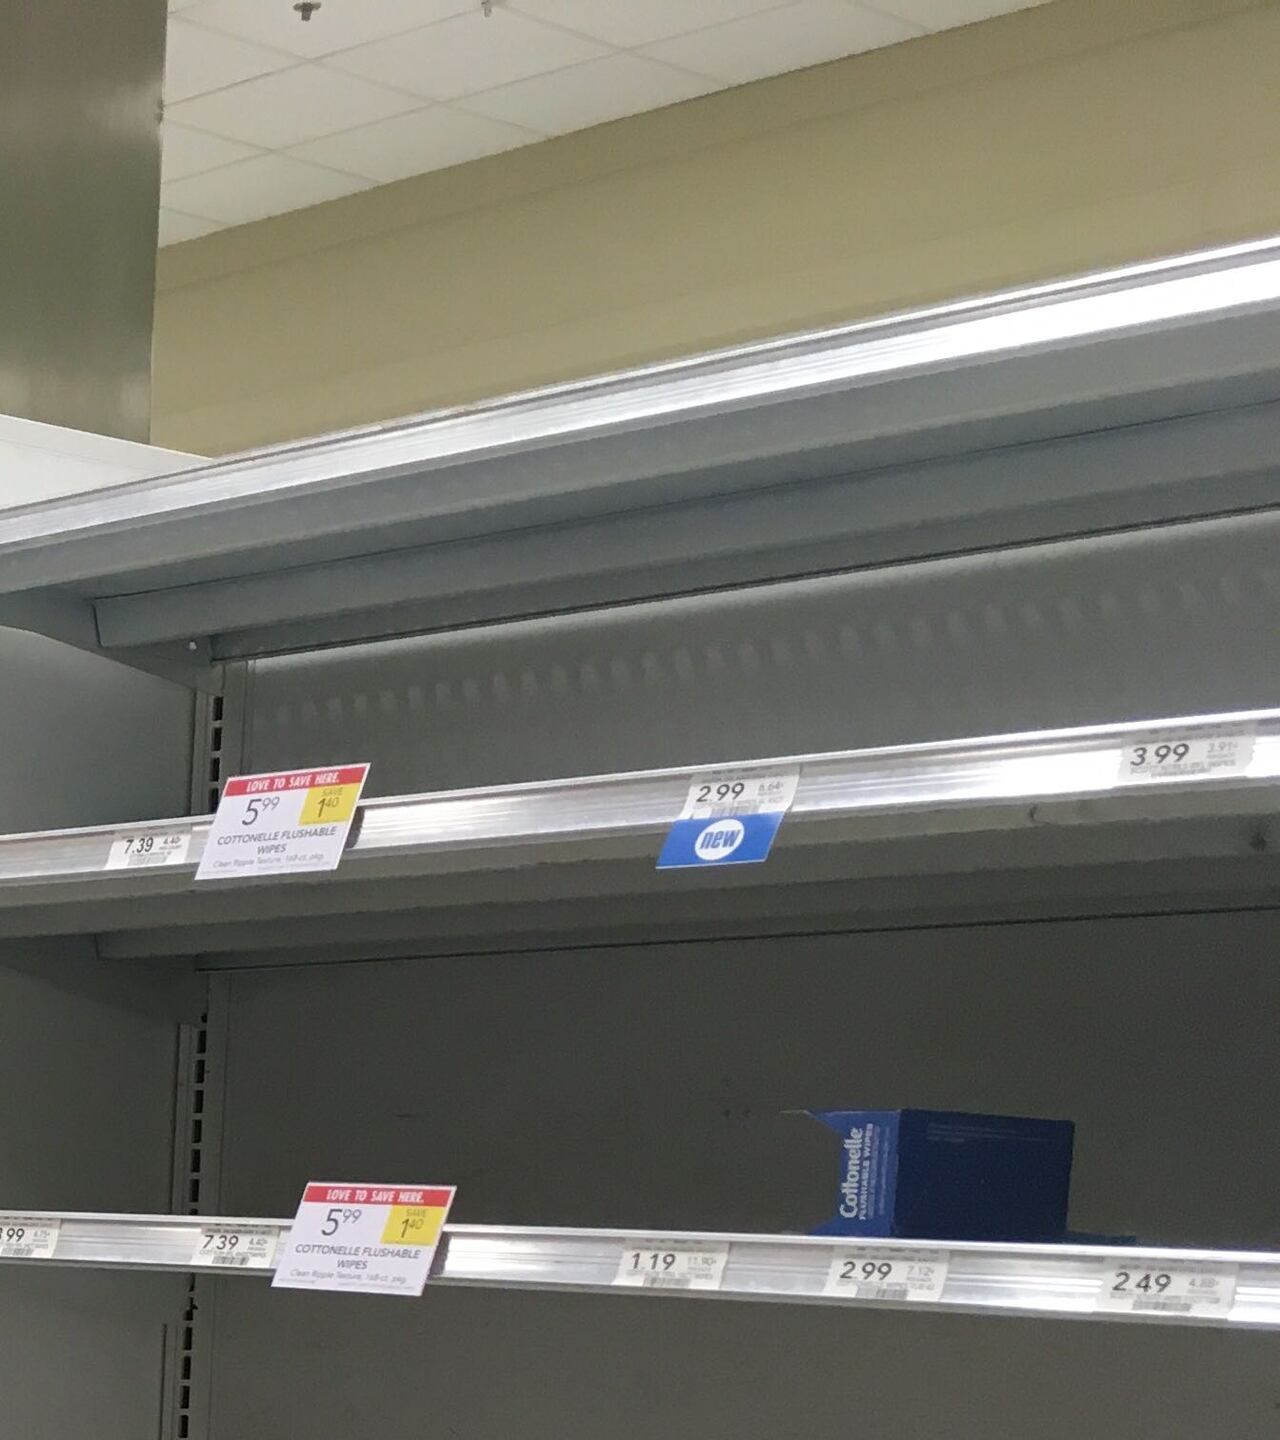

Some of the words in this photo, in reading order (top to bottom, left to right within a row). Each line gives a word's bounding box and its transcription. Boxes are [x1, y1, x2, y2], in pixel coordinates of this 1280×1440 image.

[246, 778, 268, 793] LOVE
[272, 776, 286, 790] TO
[289, 773, 311, 788] SAVE
[124, 836, 153, 854] 7.39
[216, 830, 281, 846] COTTONELLE
[280, 825, 338, 842] FLUSHABLE
[700, 829, 741, 850] new
[257, 843, 288, 856] WIPES
[863, 1122, 874, 1158] WIPES
[839, 1127, 864, 1219] Cottonelle
[326, 1188, 352, 1201] LOVE
[355, 1189, 368, 1201] TO
[370, 1189, 394, 1202] SAVE
[295, 1243, 362, 1258] COTTONELLE
[360, 1246, 422, 1260] FLUSHABLE
[336, 1259, 368, 1271] WIPES
